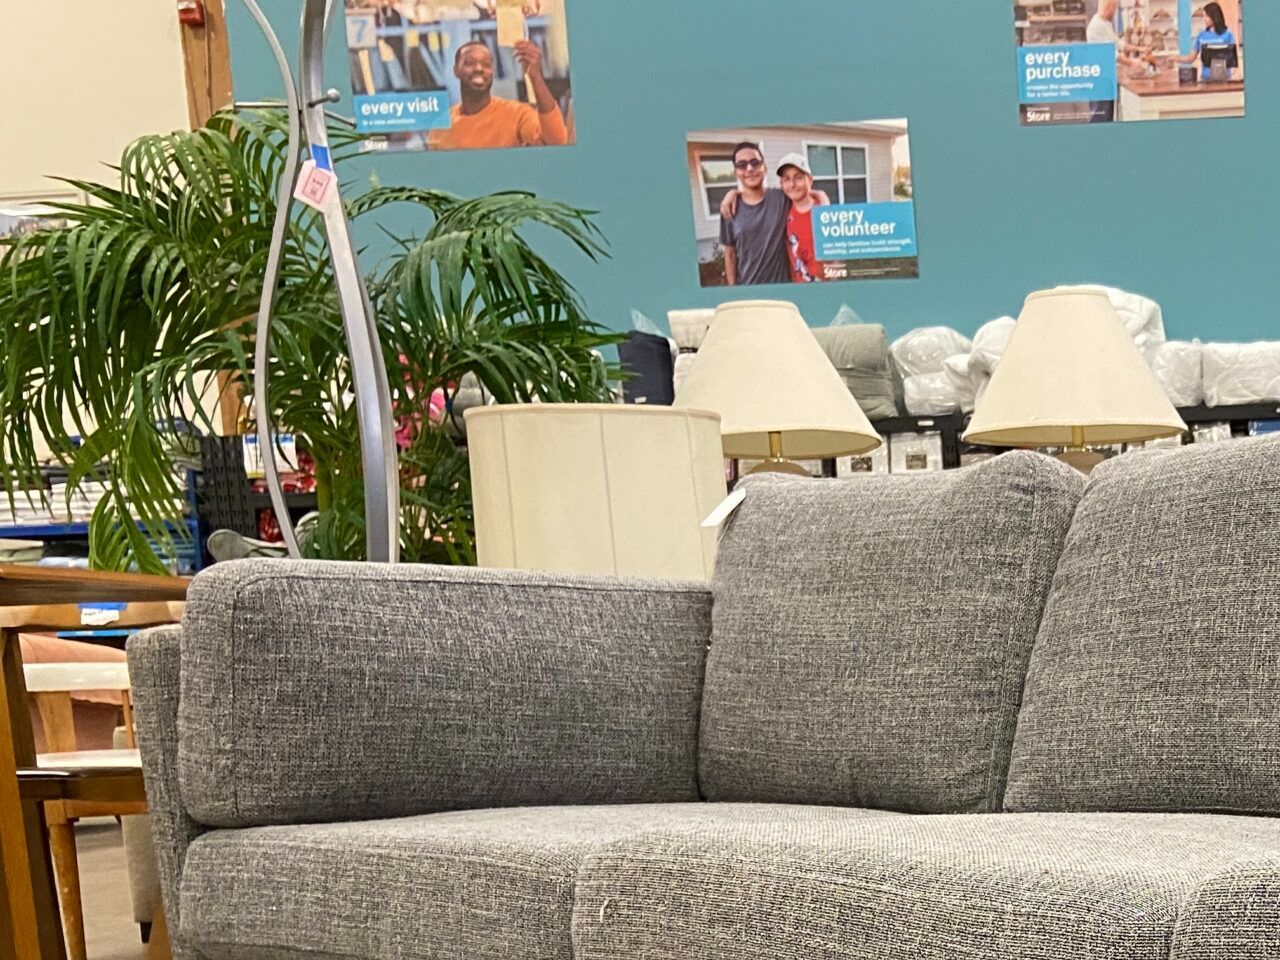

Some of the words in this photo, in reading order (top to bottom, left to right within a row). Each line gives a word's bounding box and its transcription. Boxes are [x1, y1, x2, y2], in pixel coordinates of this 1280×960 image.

[1025, 51, 1070, 67] every
[1026, 64, 1101, 82] purchase
[361, 100, 404, 117] every
[407, 96, 440, 114] visit
[1026, 111, 1051, 122] Store
[820, 210, 864, 225] every
[821, 221, 896, 237] volunteer
[823, 267, 848, 278] Store
